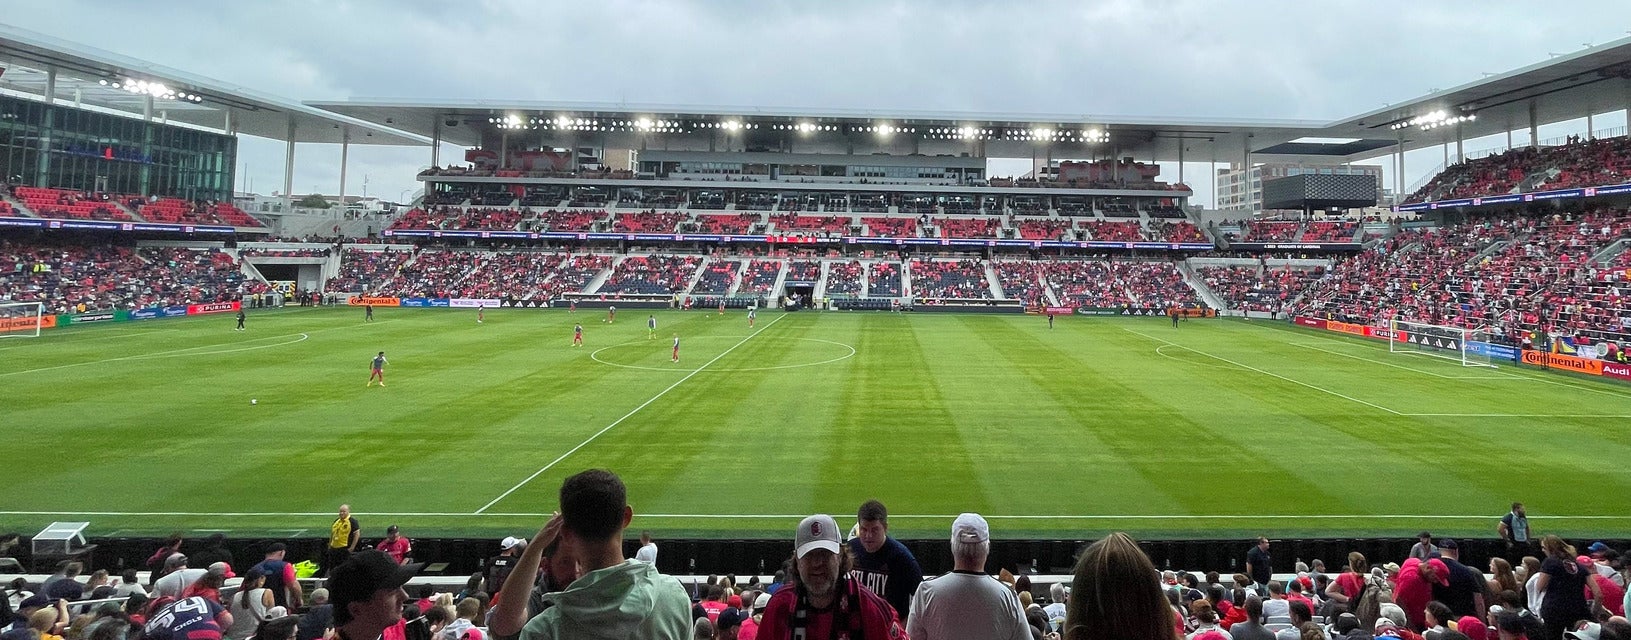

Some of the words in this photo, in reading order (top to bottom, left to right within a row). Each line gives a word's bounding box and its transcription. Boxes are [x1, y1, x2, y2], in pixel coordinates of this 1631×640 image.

[351, 296, 391, 305] Cotinental
[1376, 330, 1399, 338] PURIA
[1603, 366, 1630, 376] Audi
[866, 572, 889, 596] CITY
